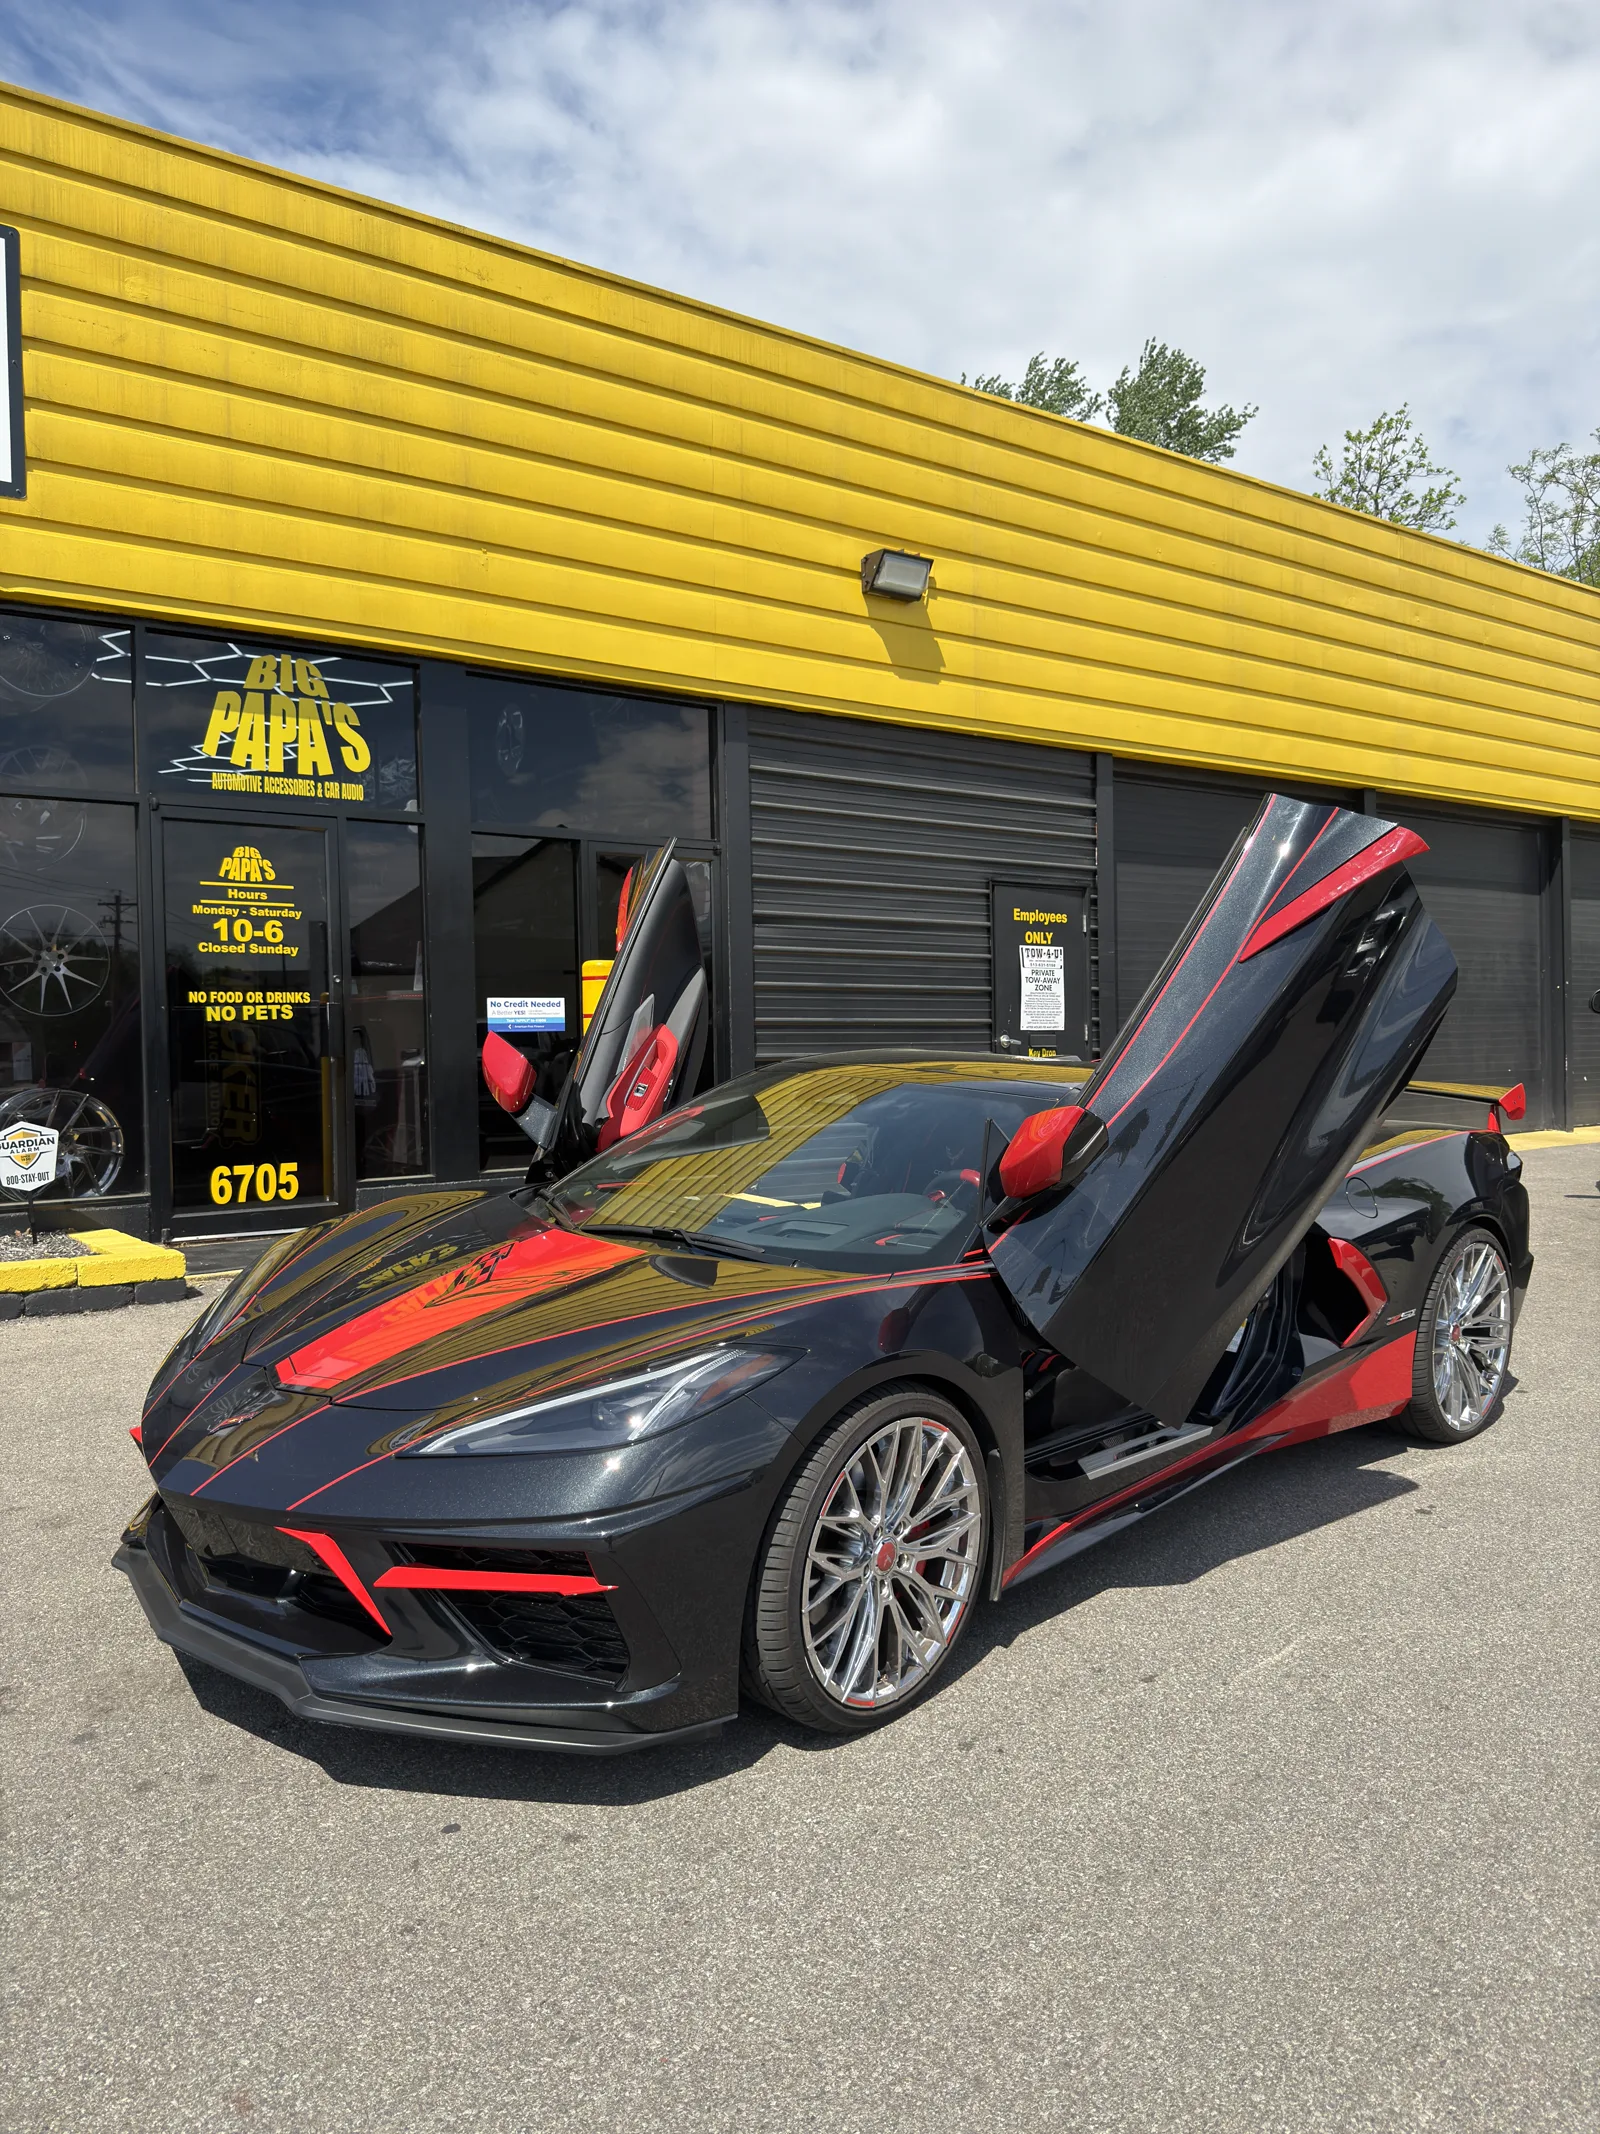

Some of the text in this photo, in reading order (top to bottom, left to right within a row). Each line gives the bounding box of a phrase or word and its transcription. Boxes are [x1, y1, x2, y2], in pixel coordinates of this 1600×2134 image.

[243, 654, 330, 699] BIG
[202, 691, 371, 776] PAPA'S
[211, 772, 364, 801] AUTOMOTIVE ACCESSORIES & CAR AUDIO
[232, 846, 263, 859] BIG
[218, 857, 276, 882] PAPA'S
[228, 888, 268, 900] Hours
[192, 904, 240, 918] Monday
[249, 907, 302, 920] Saturday
[1013, 908, 1067, 925] Employees
[213, 918, 284, 943] 10-6
[1025, 931, 1053, 944] ONLY
[198, 942, 299, 957] Closed Sunday
[1025, 976, 1061, 984] TOW-AWAY
[1031, 969, 1055, 977] PRIVATE
[1034, 984, 1053, 992] ZONE
[189, 991, 311, 1004] NO FOOD OR DRINKS
[490, 1000, 561, 1008] No Credit Needed
[206, 1004, 294, 1022] NO PETS
[1028, 1048, 1041, 1058] Key
[0, 1137, 55, 1149] UARDIAN
[6, 1171, 50, 1186] 800-STAY-OUT
[210, 1162, 299, 1205] 6705
